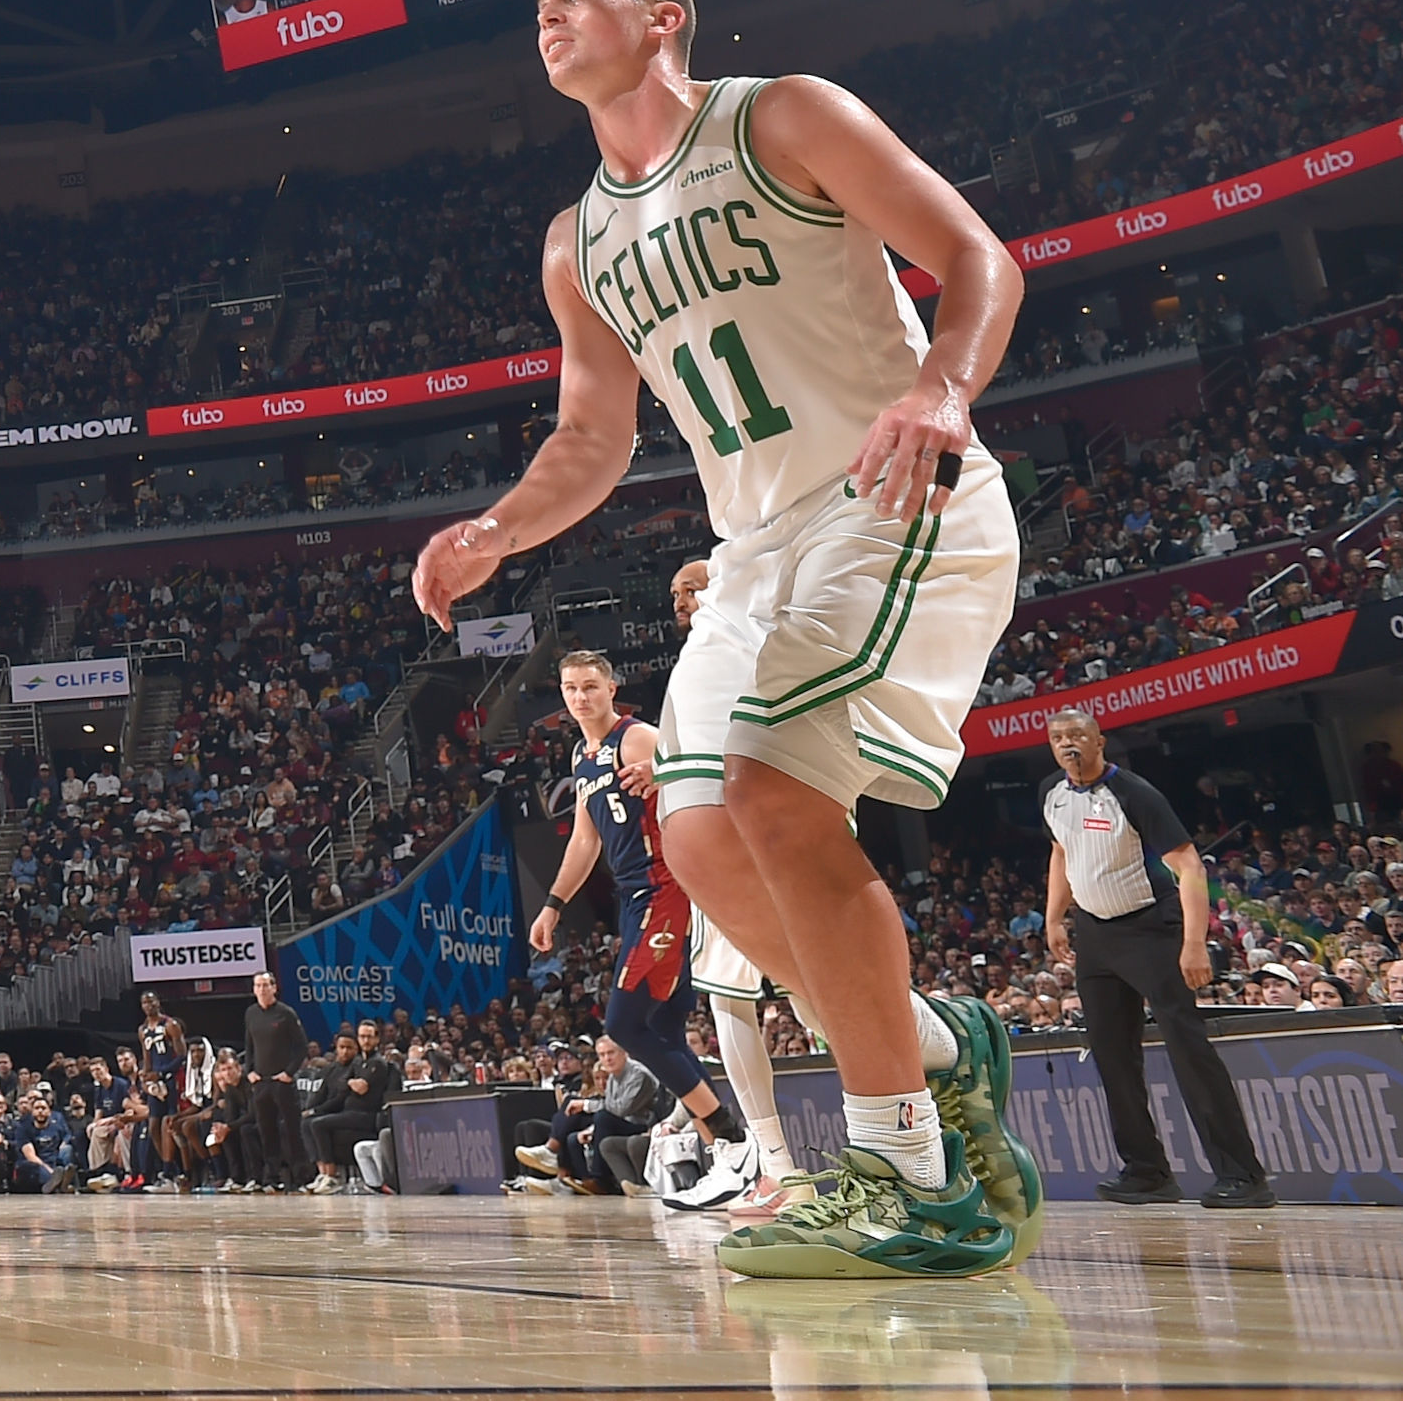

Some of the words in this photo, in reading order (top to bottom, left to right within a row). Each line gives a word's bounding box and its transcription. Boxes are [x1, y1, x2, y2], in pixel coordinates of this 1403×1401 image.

[276, 10, 344, 47] fubo
[1055, 111, 1078, 128] 205
[680, 159, 734, 188] Amica
[1022, 236, 1071, 264] fubo
[1115, 210, 1168, 239] fubo
[1211, 182, 1262, 211] fubo
[1303, 149, 1355, 180] fubo
[595, 200, 781, 356] CELTICS
[222, 304, 241, 316] 203
[252, 300, 272, 313] 204
[181, 407, 224, 427] fubo
[262, 397, 305, 417] fubo
[344, 387, 388, 407] fubo
[425, 373, 468, 395] fubo
[506, 357, 550, 380] fubo
[673, 320, 793, 458] 11
[38, 416, 139, 444] KNOW.
[296, 531, 331, 546] M103
[55, 670, 124, 687] CLIFFS
[1106, 683, 1167, 716] GAMES
[1167, 666, 1204, 697] LIVE
[1204, 653, 1255, 687] WITH
[1255, 644, 1299, 676] fubo
[606, 792, 629, 825] 5
[419, 902, 457, 931] Full
[461, 907, 514, 938] Court
[139, 941, 256, 968] TRUSTEDSEC
[439, 935, 502, 967] Power
[296, 964, 395, 983] COMCAST
[299, 985, 396, 1003] BUSINESS
